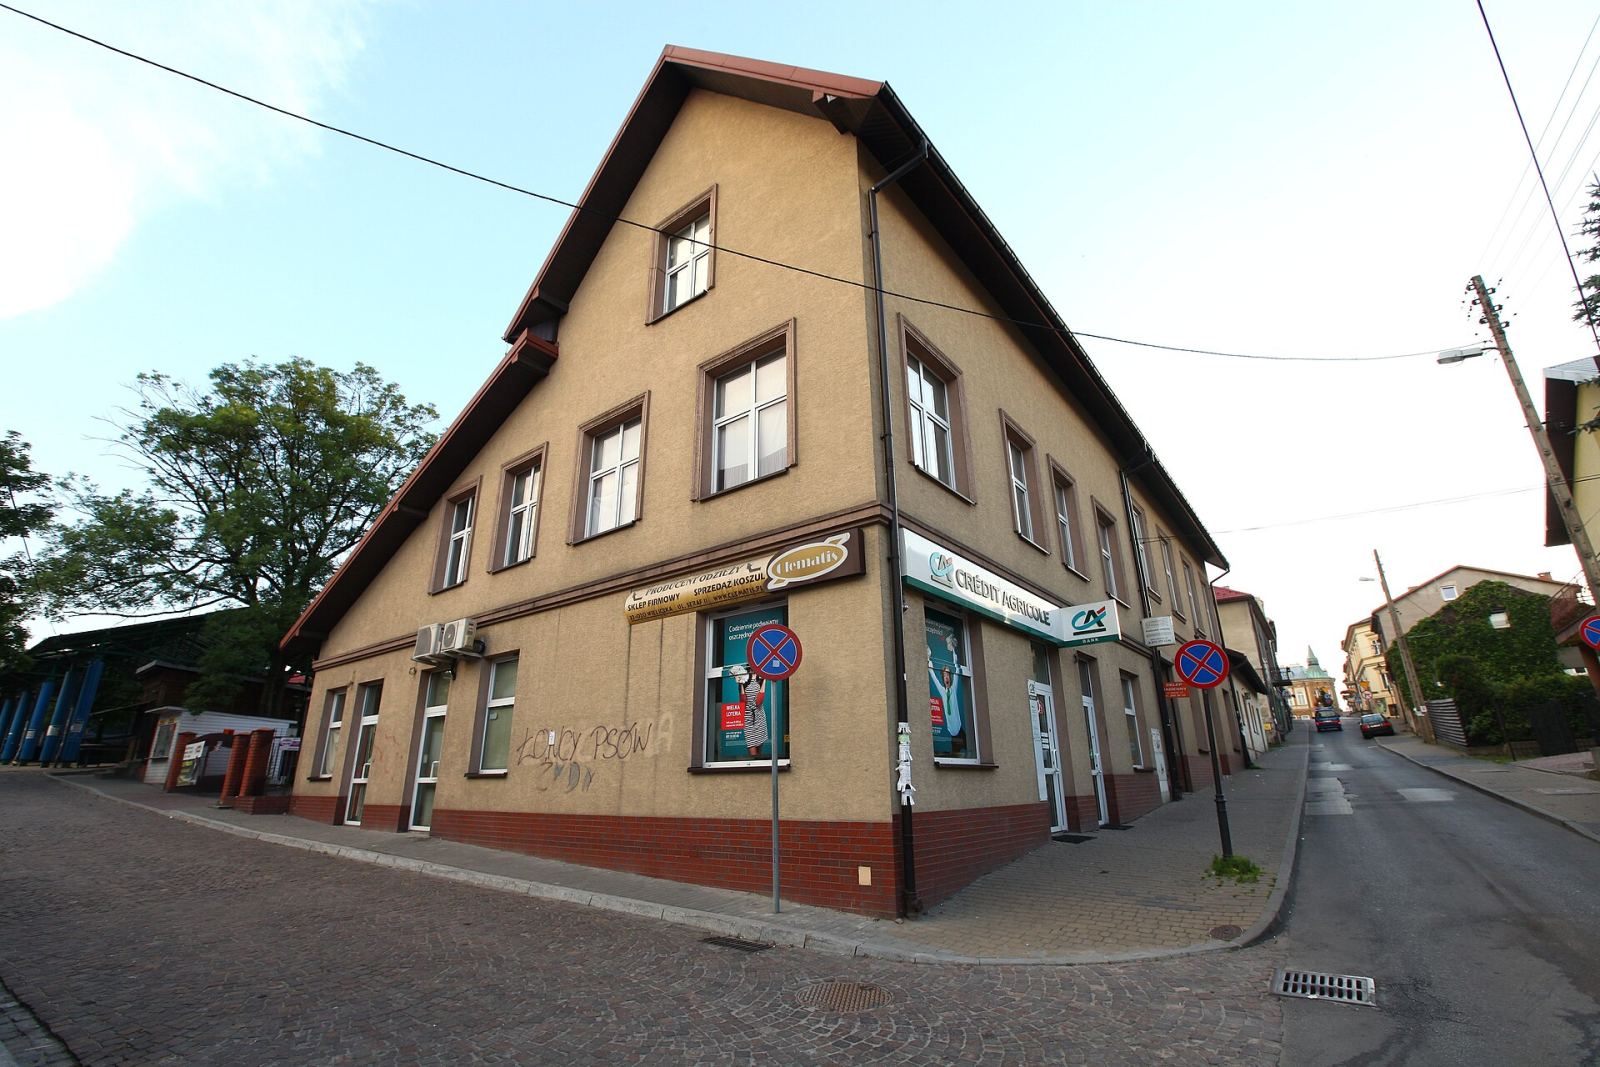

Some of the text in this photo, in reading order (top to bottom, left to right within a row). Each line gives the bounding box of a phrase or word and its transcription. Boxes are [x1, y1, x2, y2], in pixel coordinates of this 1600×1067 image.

[627, 600, 647, 611] SKLEP
[647, 593, 681, 607] FIRMOWY
[733, 572, 765, 587] KOSZUL
[955, 568, 1051, 626] CRÉDIT AGRICOLE
